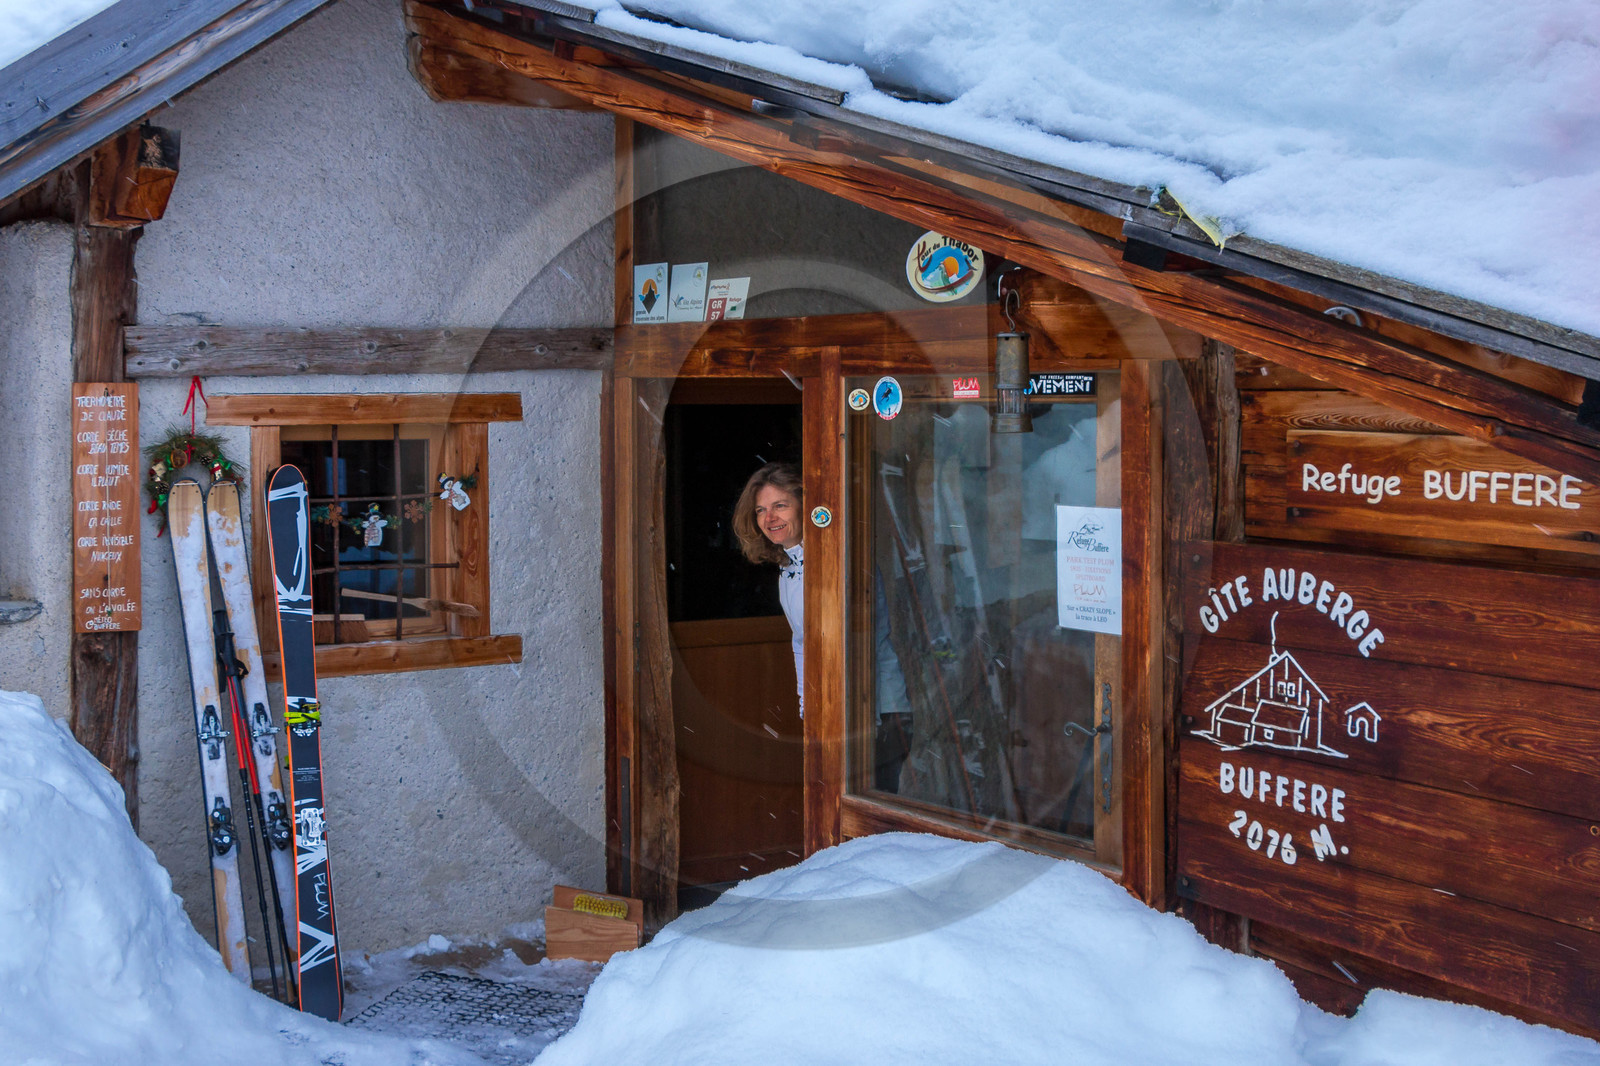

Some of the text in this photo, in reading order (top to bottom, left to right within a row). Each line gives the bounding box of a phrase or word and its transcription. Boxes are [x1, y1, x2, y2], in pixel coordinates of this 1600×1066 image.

[942, 236, 979, 262] Thabor
[712, 300, 723, 309] GR
[711, 311, 720, 320] 57
[952, 377, 980, 390] PLUM
[80, 409, 127, 421] DE CLAUDE
[77, 431, 99, 443] CORDE
[110, 442, 130, 454] TEMPS
[77, 464, 99, 475] CORDE
[91, 477, 97, 487] IL
[1302, 462, 1583, 510] Refuge BUFFERE
[78, 501, 99, 511] CORDE
[77, 537, 98, 547] CORDE
[80, 587, 126, 599] SANS CORDE
[1073, 583, 1107, 598] PLUM
[1199, 567, 1386, 658] GÎTE AUBERGE
[1219, 762, 1346, 823] BUFFERE
[1228, 810, 1350, 865] 2076 M.
[312, 872, 330, 921] PLUM
